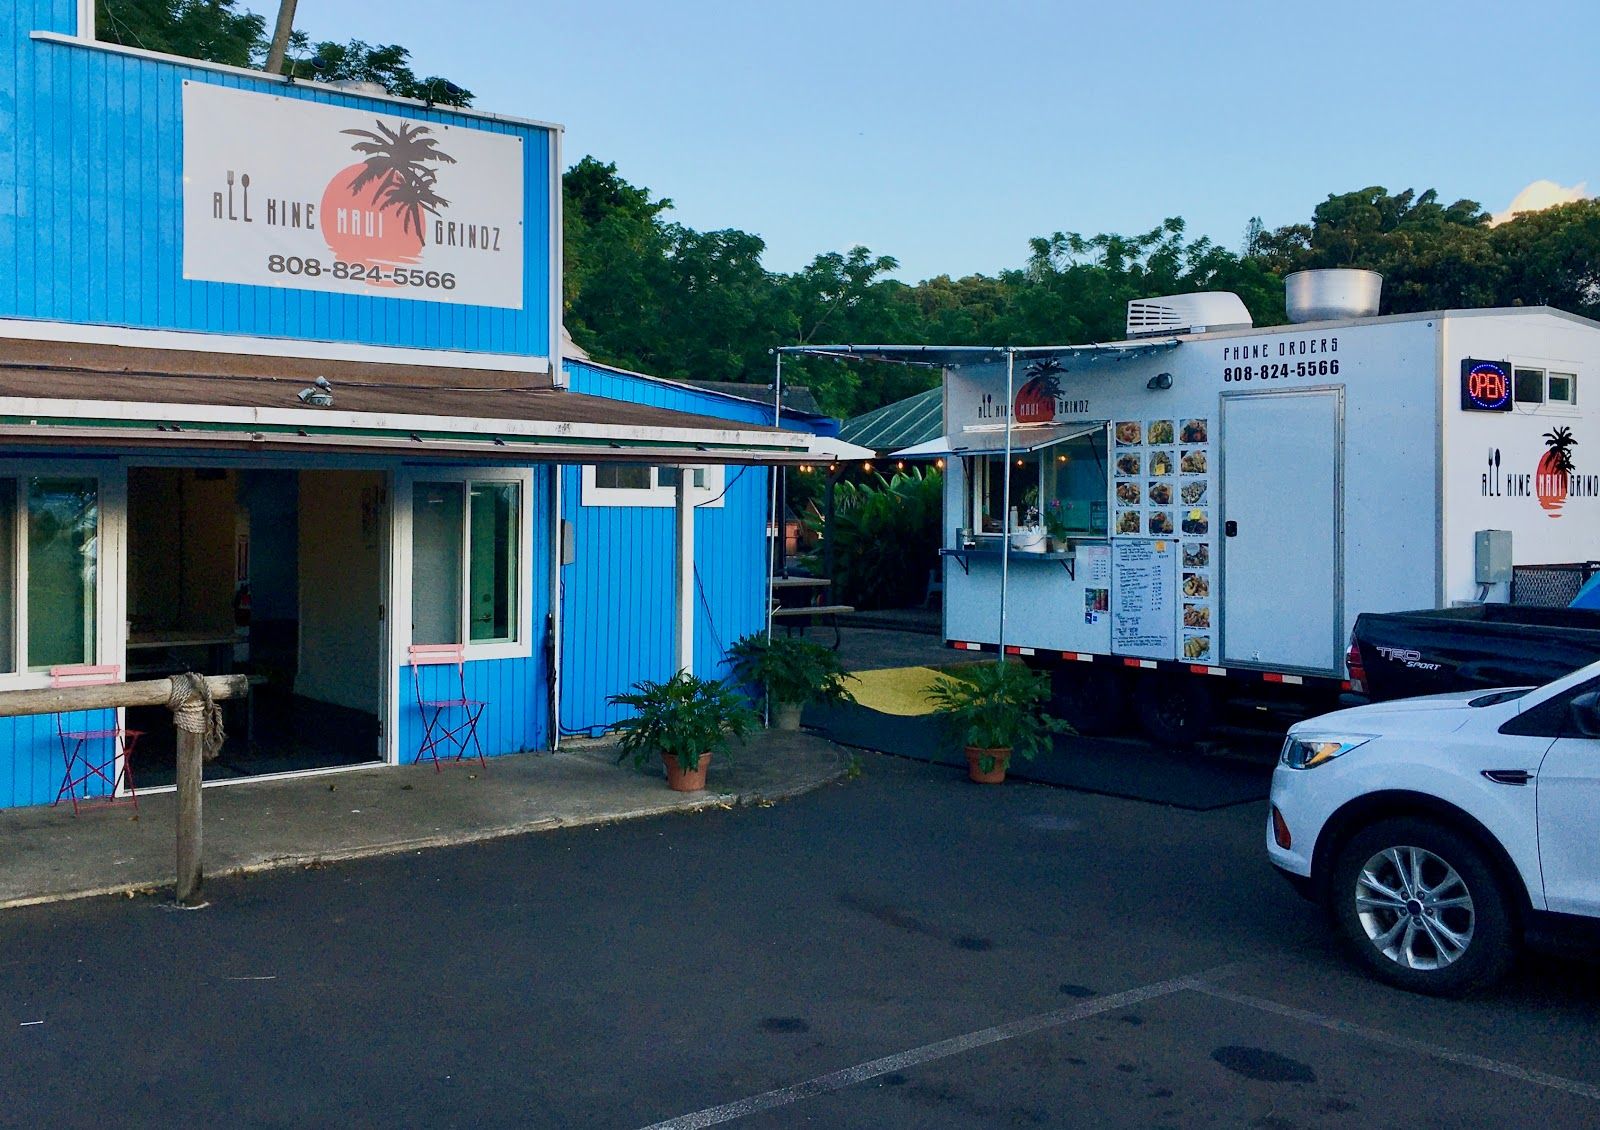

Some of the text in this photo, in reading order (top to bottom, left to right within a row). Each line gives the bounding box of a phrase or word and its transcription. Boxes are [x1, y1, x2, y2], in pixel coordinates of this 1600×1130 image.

[213, 169, 253, 223] ALL
[337, 206, 383, 239] MAUI
[435, 219, 501, 252] GRINDZ
[267, 254, 456, 290] 808-824-5566
[1224, 338, 1338, 361] PHONE ORDERS
[1224, 359, 1339, 382] 808-824-5566
[1470, 373, 1505, 398] OPEN
[1020, 403, 1039, 416] MAUI
[1059, 400, 1089, 414] GRINDZ
[1482, 447, 1501, 497] ALL
[1539, 474, 1562, 497] MAUI
[1376, 646, 1421, 663] TRD
[1406, 661, 1441, 671] SPORT
